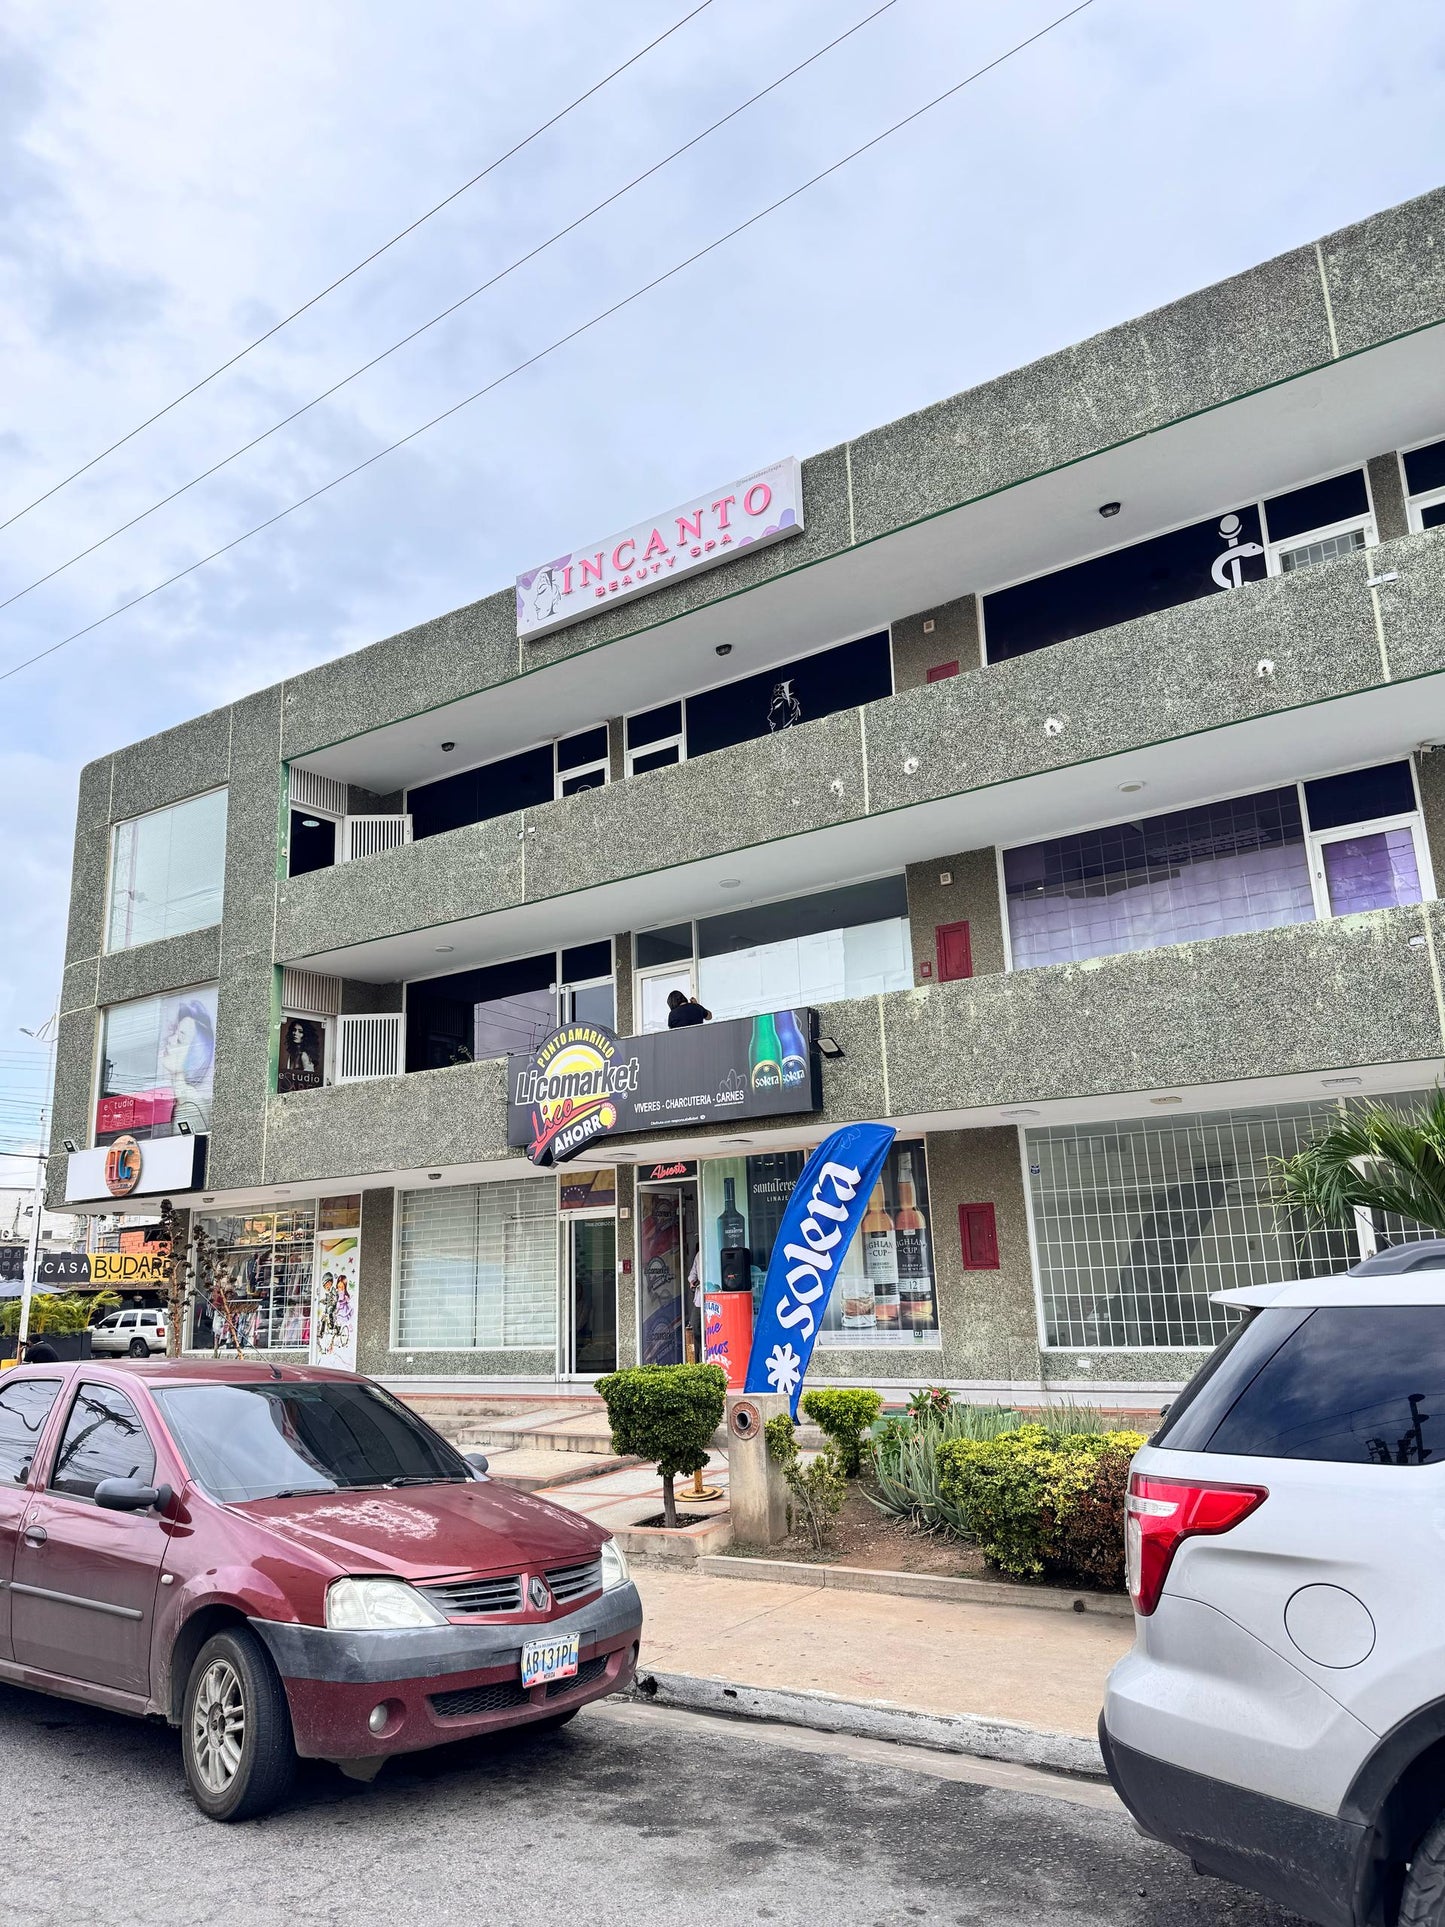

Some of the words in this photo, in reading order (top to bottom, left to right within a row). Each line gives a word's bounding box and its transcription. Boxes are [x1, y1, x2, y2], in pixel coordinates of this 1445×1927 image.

[562, 483, 772, 597] INCANTO
[595, 555, 676, 597] BEAUTY
[689, 533, 732, 557] SPA
[537, 1032, 566, 1068] PUNTO
[567, 1028, 615, 1059] AMARILLO
[515, 1057, 639, 1105] Licomarket
[755, 1074, 780, 1088] solera
[782, 1069, 806, 1084] solera
[634, 1100, 661, 1113] VIVERES
[666, 1094, 712, 1109] CHARCUTERIA
[716, 1090, 745, 1103] CARNES
[531, 1098, 574, 1143] Lico
[753, 1178, 797, 1194] santaTeres
[776, 1161, 861, 1343] solera
[872, 1249, 888, 1257] CUP
[44, 1262, 89, 1274] CASA
[909, 1281, 918, 1290] 12
[526, 1643, 575, 1676] AB131PL
